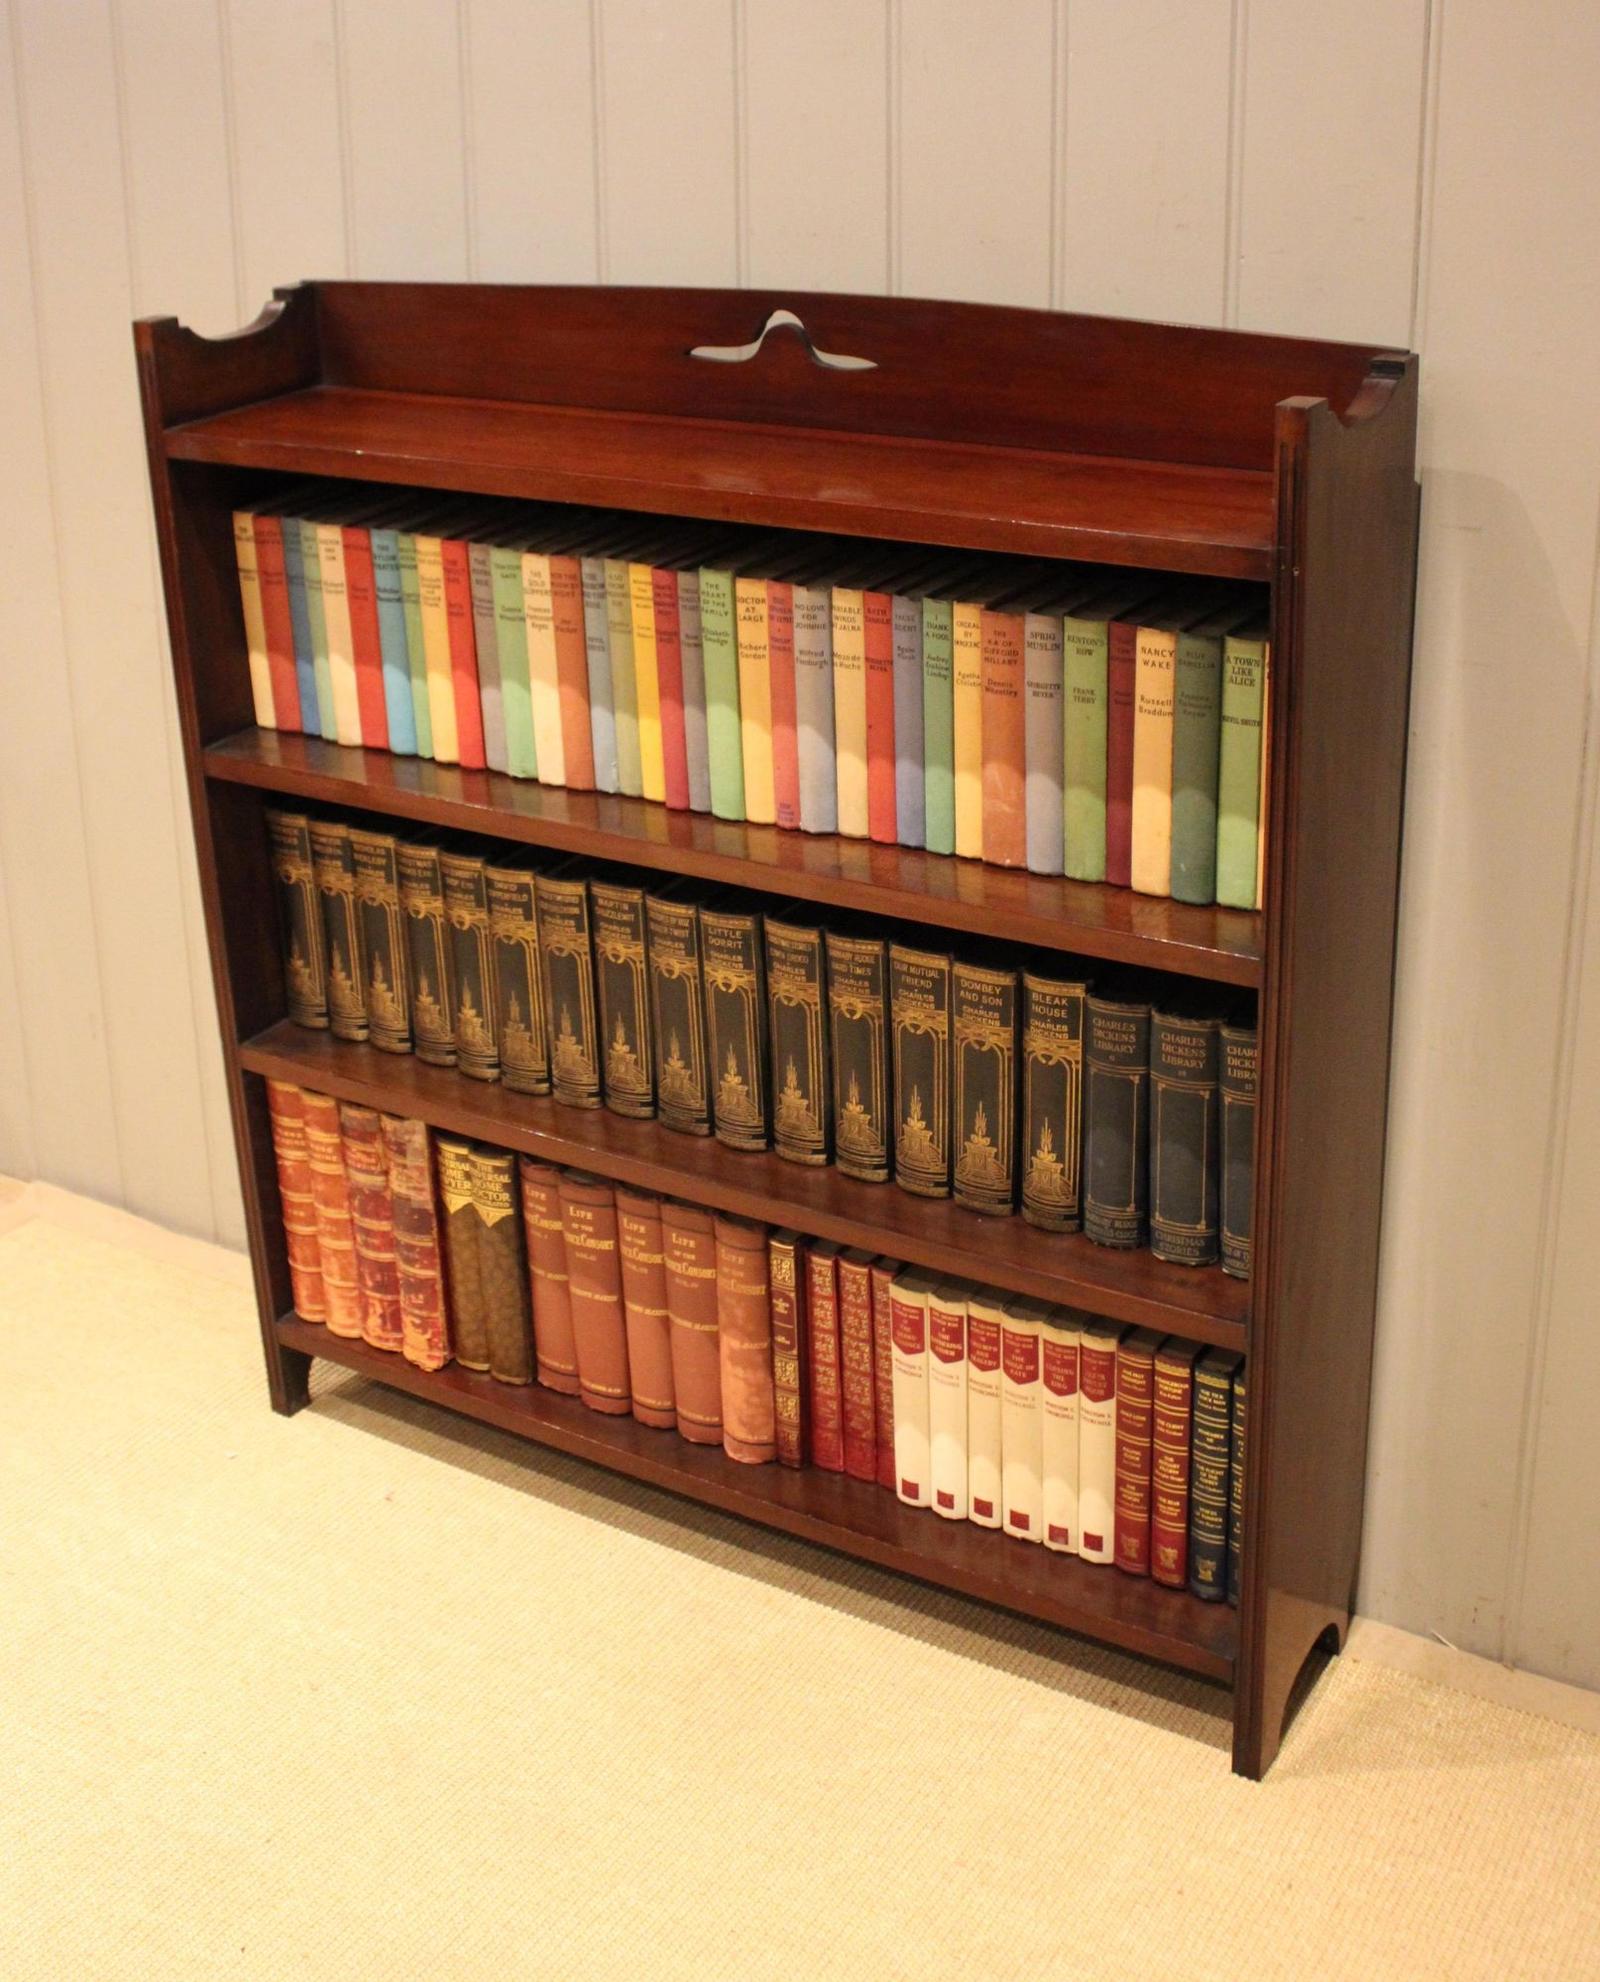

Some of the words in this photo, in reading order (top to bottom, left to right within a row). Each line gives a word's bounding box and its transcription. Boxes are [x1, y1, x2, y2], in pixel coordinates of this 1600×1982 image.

[705, 582, 720, 590] THE
[712, 600, 726, 608] THE
[739, 614, 764, 624] LARGE
[802, 613, 818, 621] FOR
[993, 629, 1007, 638] THE
[1029, 631, 1057, 642] SPRIG
[1026, 640, 1062, 652] MUSLIN
[1140, 646, 1175, 658] NANCY
[1142, 658, 1172, 671] WAKE
[1235, 656, 1261, 669] TOWN
[1231, 666, 1253, 677] LIKE
[1228, 676, 1257, 688] ALICE
[1140, 693, 1173, 707] Russell
[1138, 705, 1174, 719] Braddon
[707, 927, 744, 940] LITTLE
[708, 937, 744, 950] DORRIT
[911, 965, 941, 981] MUTUAL
[900, 975, 933, 989] FRIEND
[960, 978, 1003, 996] DOMBEY
[959, 989, 979, 1002] AND
[981, 995, 1003, 1007] SON
[1031, 991, 1070, 1007] BLEAK
[1031, 1003, 1069, 1019] HOUSE
[1029, 1017, 1069, 1033] CHARLES
[1092, 1017, 1137, 1033] CHARLES
[1092, 1029, 1137, 1044] DICKENS
[1160, 1032, 1208, 1048] CHARLES
[1093, 1039, 1137, 1055] LIBRARY
[1160, 1042, 1208, 1058] DICKENS
[1161, 1052, 1205, 1070] LIBRARY
[1227, 1068, 1258, 1082] LIBRA
[568, 1205, 593, 1220] LIFE
[622, 1216, 647, 1234] LIFE
[671, 1232, 696, 1250] LIFE
